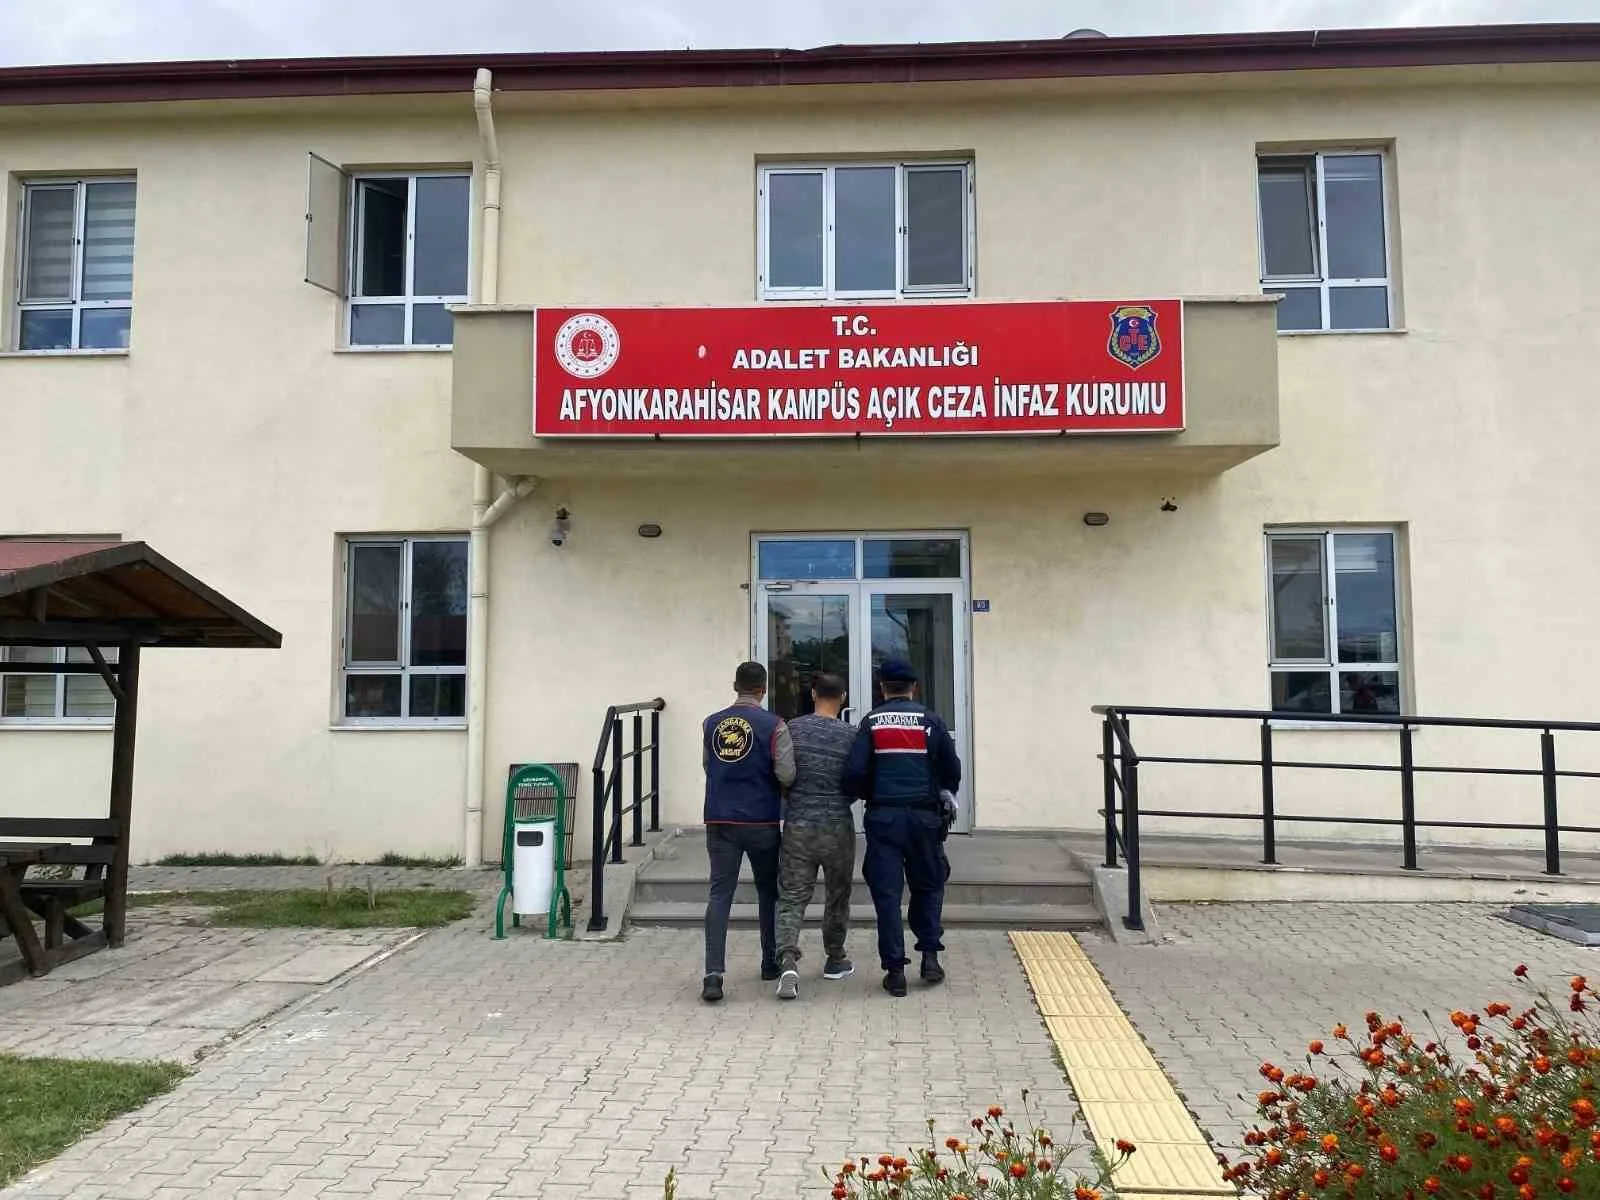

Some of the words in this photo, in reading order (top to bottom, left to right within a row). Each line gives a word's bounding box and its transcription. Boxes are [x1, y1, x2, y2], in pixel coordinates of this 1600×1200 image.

[831, 315, 877, 337] T.C.
[732, 349, 830, 370] ADALET
[838, 341, 979, 370] BAKANLIĞI
[559, 380, 761, 421] AFYONKARAHİSAR
[768, 381, 861, 420] KAMPÜS
[866, 386, 922, 427] AÇIK
[927, 385, 988, 418] CEZA
[994, 377, 1059, 417] İNFAZ
[1066, 382, 1167, 416] KURUMU
[874, 714, 919, 727] JANDARMA
